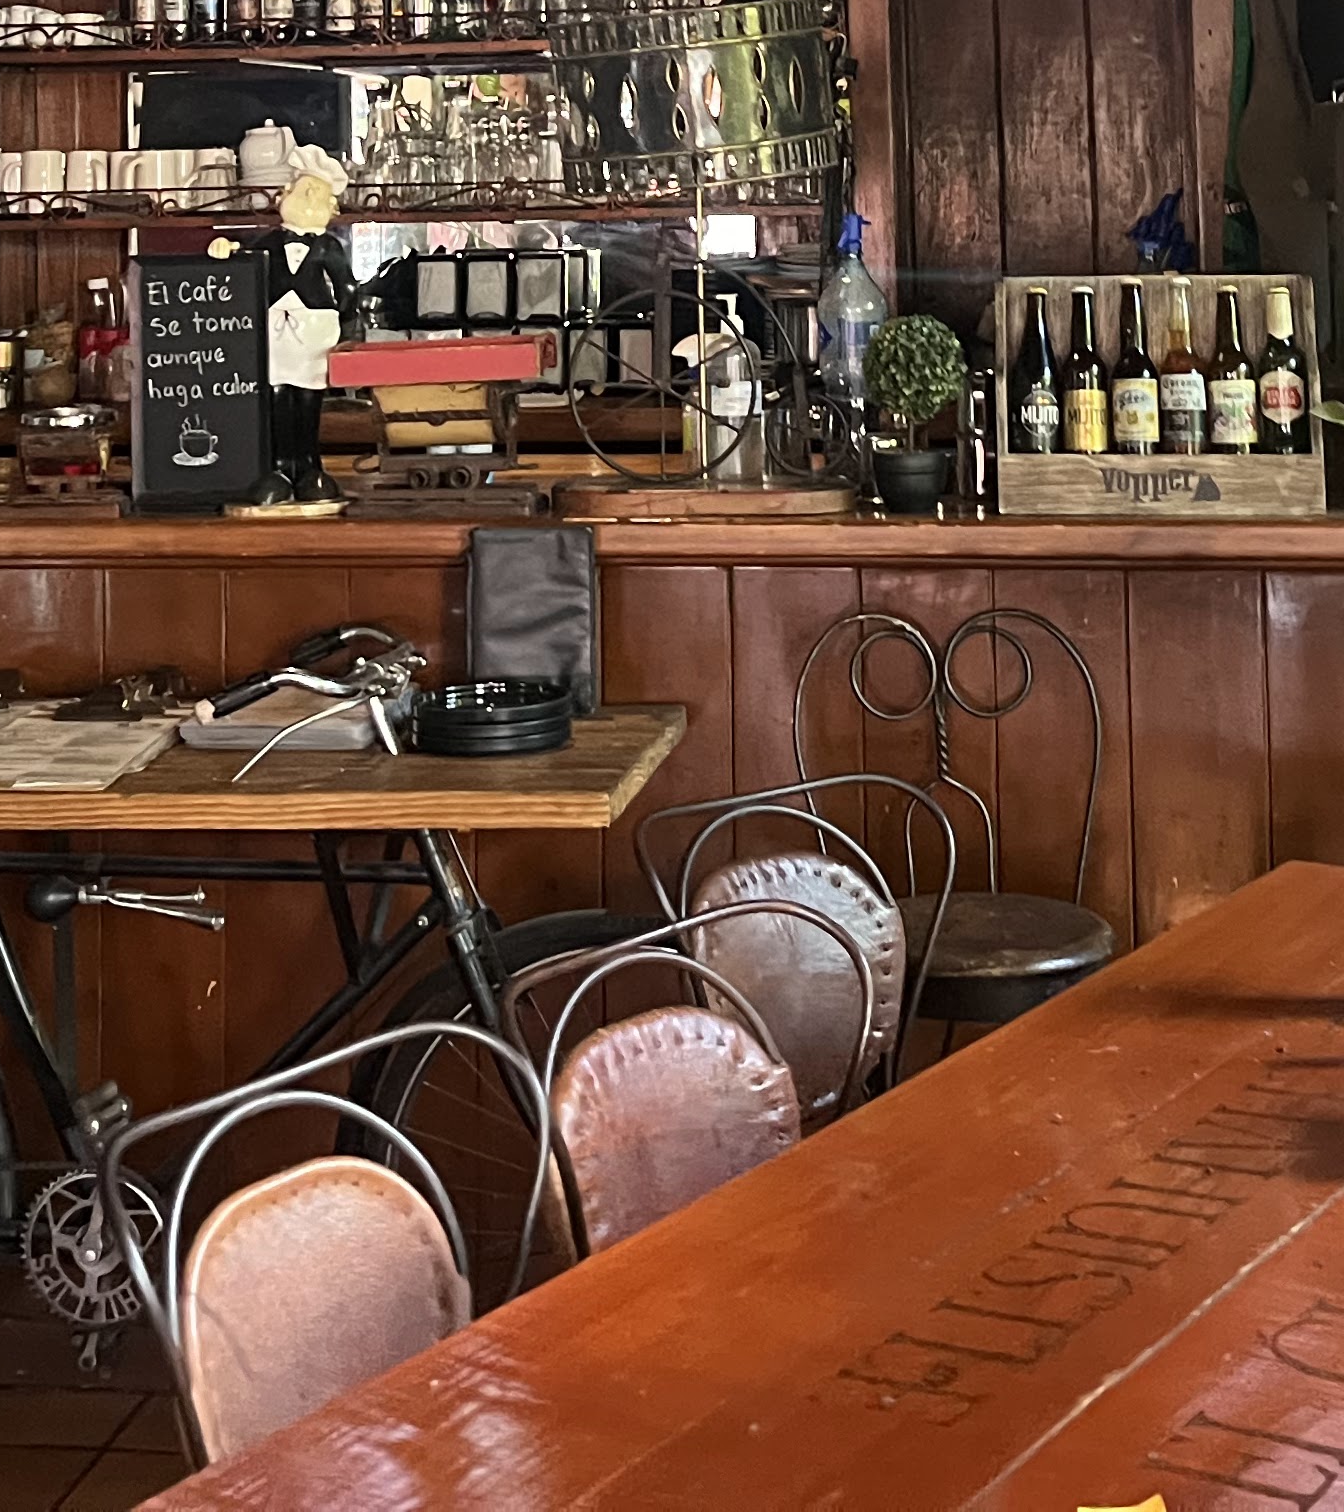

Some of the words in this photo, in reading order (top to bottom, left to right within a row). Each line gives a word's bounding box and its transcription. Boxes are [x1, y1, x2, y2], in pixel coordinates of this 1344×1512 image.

[148, 281, 170, 306] El
[178, 275, 232, 304] Café
[193, 311, 254, 334] toma
[147, 346, 225, 376] aunque
[148, 378, 203, 408] haga
